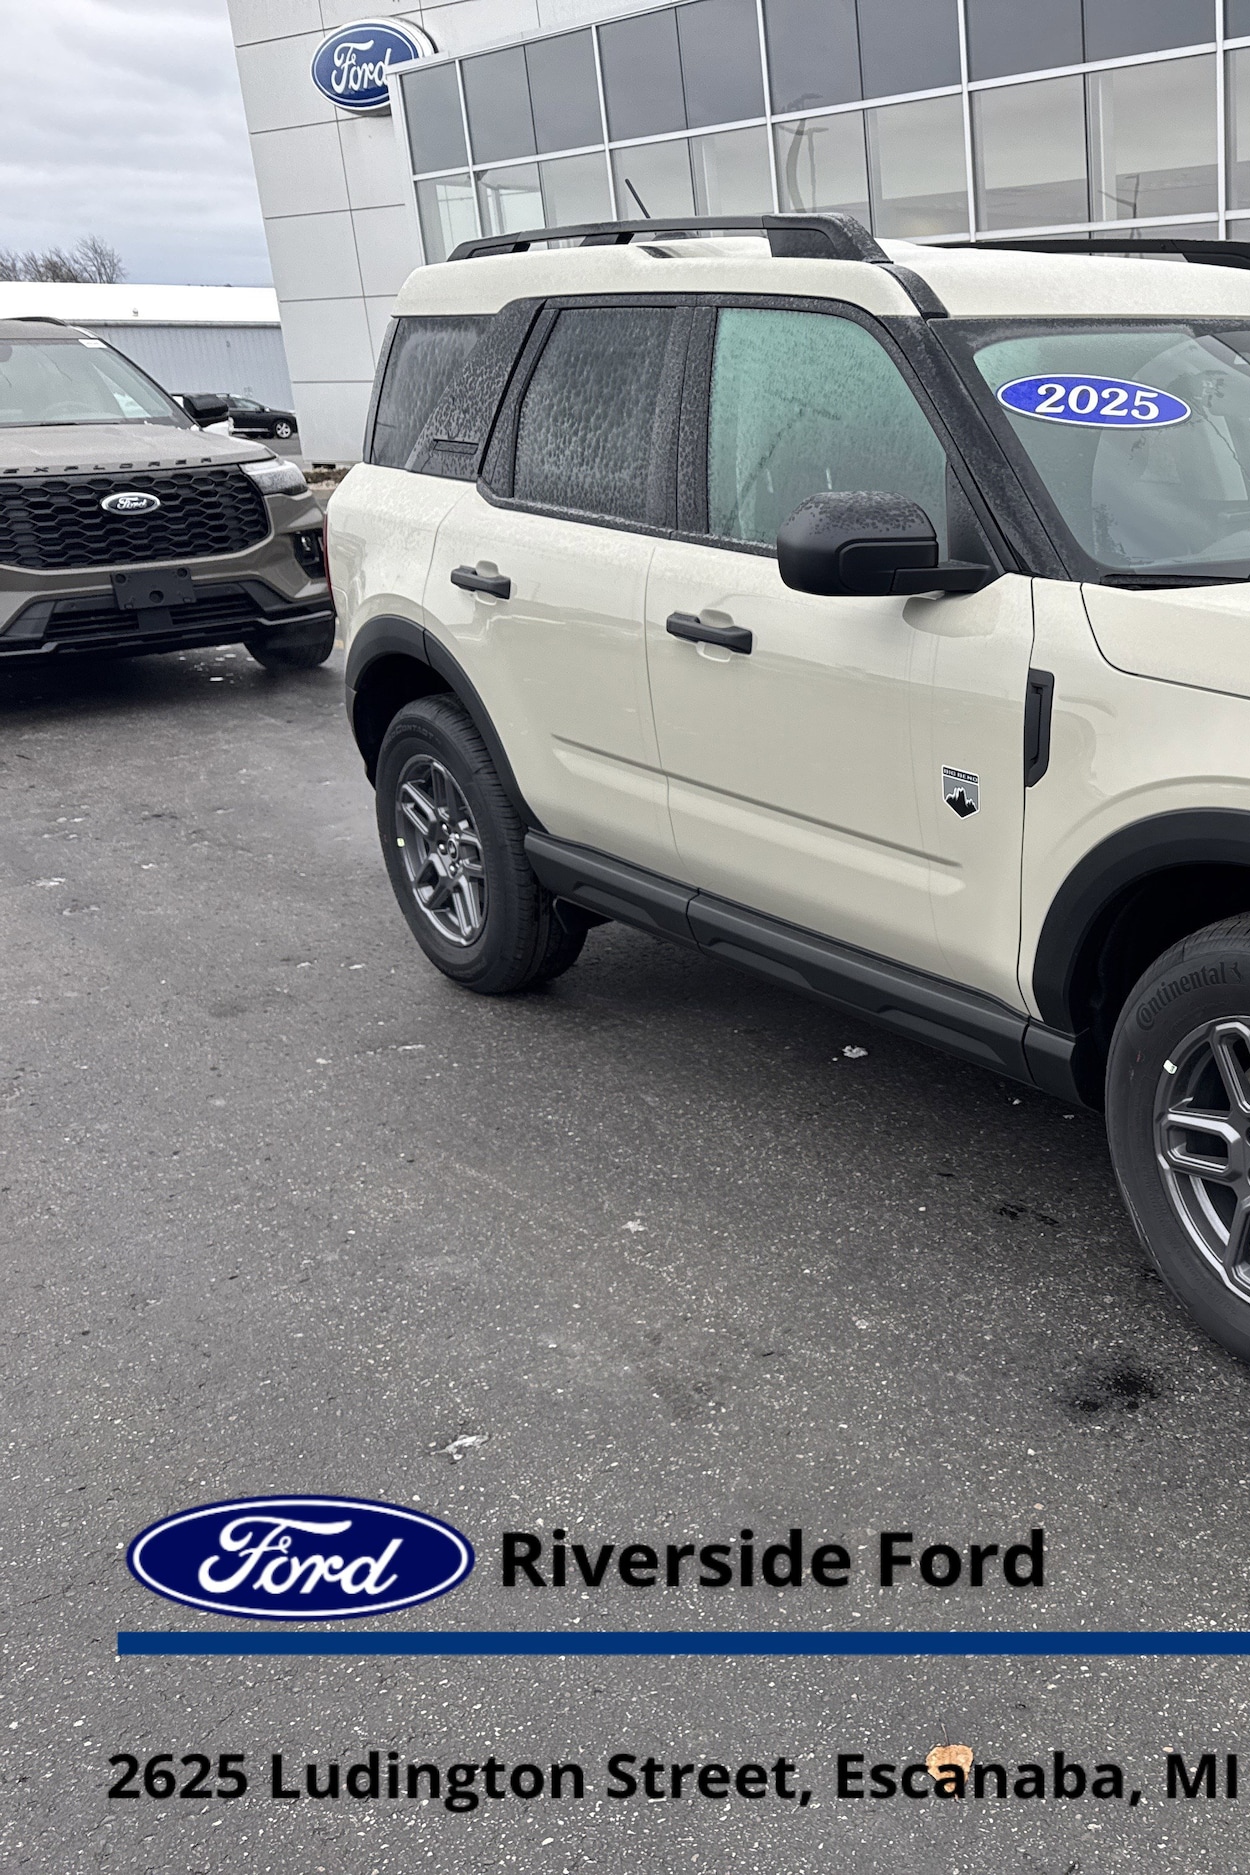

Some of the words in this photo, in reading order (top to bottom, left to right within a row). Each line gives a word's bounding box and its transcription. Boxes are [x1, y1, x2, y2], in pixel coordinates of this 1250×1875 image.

[331, 39, 392, 94] Ford
[1035, 383, 1159, 421] 2025
[116, 496, 147, 510] Ford
[1136, 961, 1228, 1031] Continental
